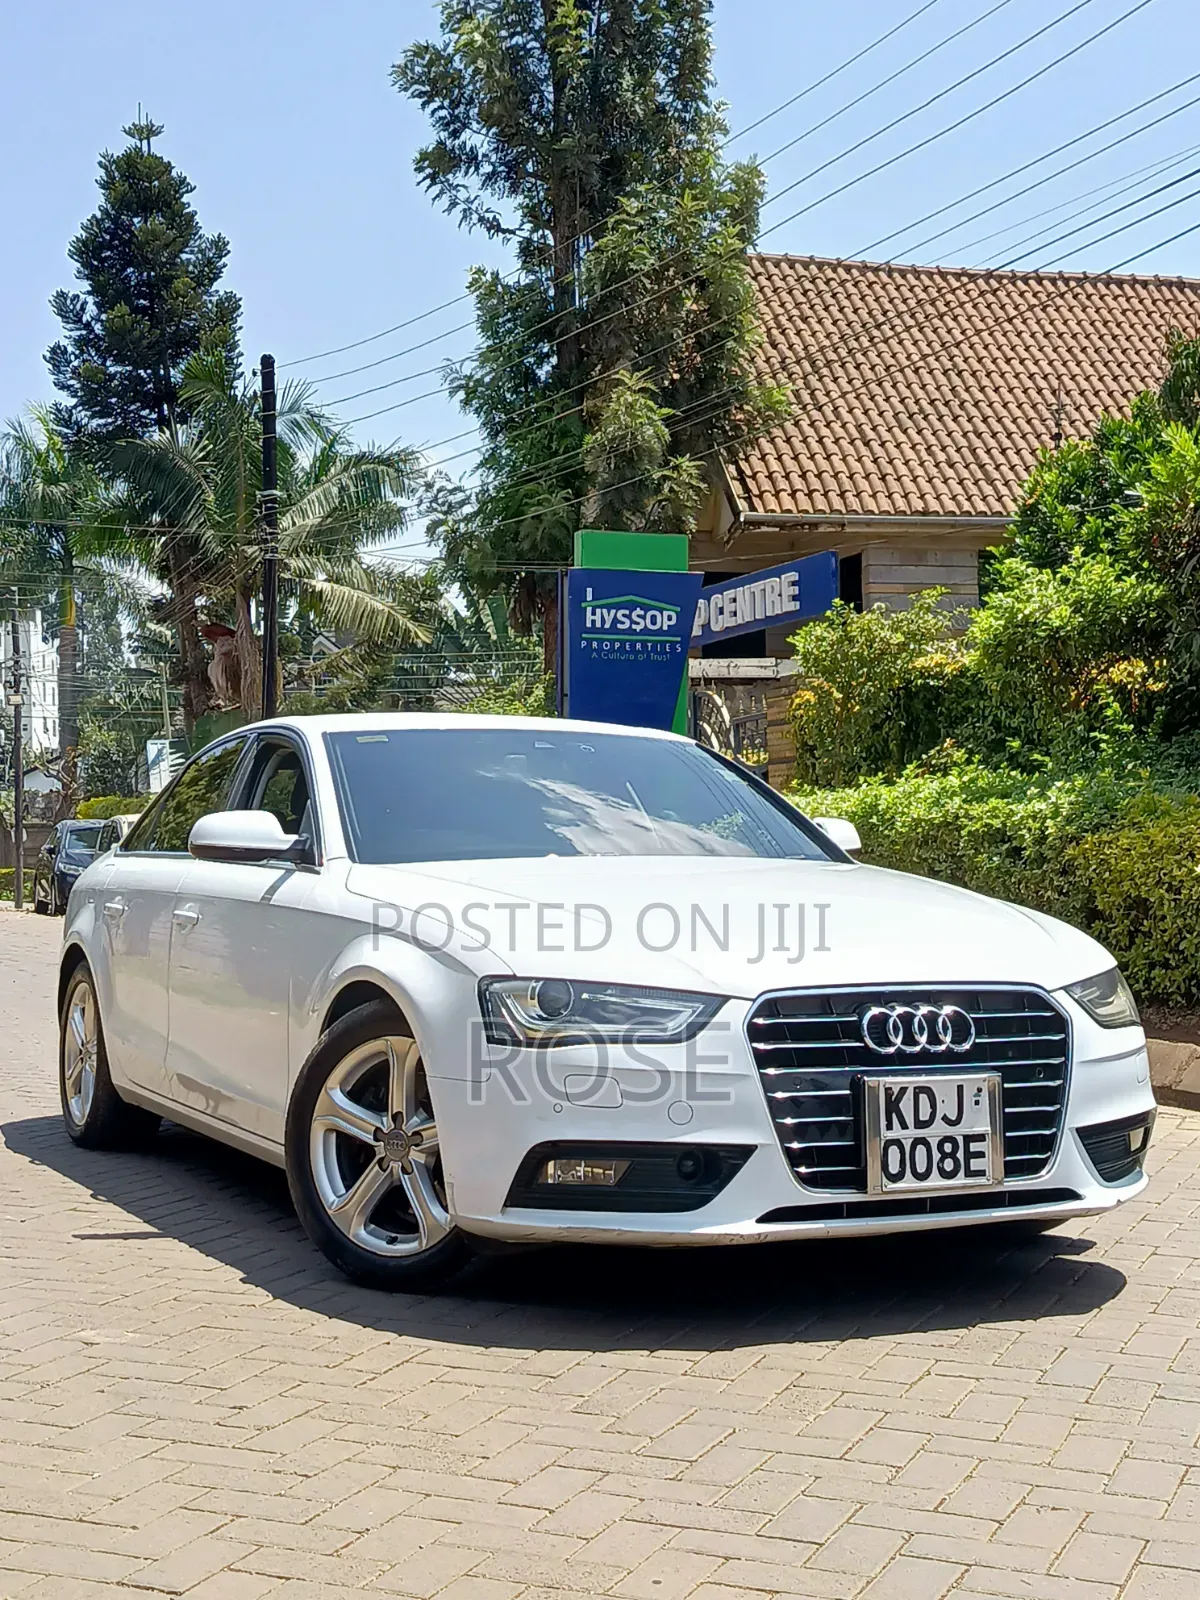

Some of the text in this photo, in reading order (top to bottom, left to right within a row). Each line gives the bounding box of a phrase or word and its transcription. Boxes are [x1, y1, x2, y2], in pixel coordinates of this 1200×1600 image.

[710, 572, 800, 631] CENTRE
[581, 641, 682, 652] PROPERTIES
[637, 652, 647, 661] of
[650, 653, 670, 661] Trust
[885, 1084, 964, 1131] KDJ
[882, 1133, 987, 1183] 008E
